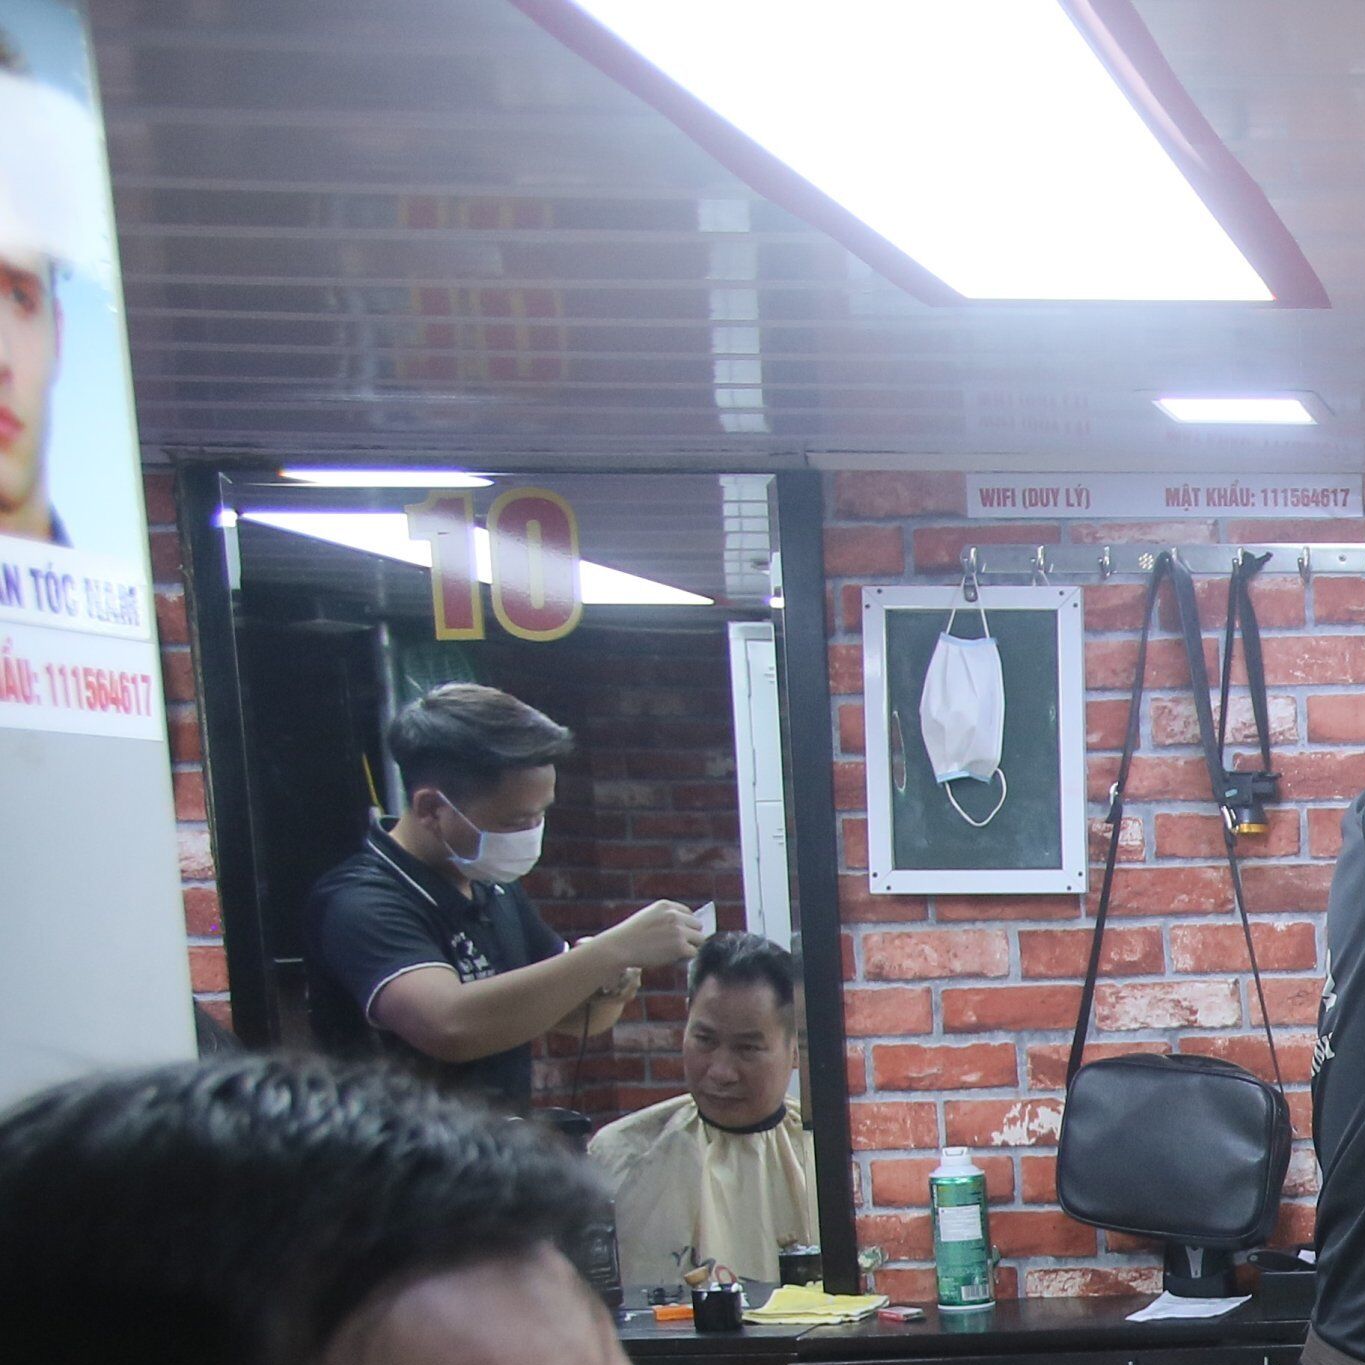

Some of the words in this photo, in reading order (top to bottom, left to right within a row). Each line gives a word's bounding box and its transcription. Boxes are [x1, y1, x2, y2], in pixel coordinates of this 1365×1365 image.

[979, 487, 1016, 507] WIFI
[1022, 487, 1060, 509] (DUY
[1065, 483, 1091, 510] LÝ)
[1165, 483, 1200, 512] MẬT
[1261, 488, 1350, 507] 111564617
[29, 562, 78, 618] TÓC
[404, 487, 583, 641] 10
[44, 662, 152, 717] 111564617
